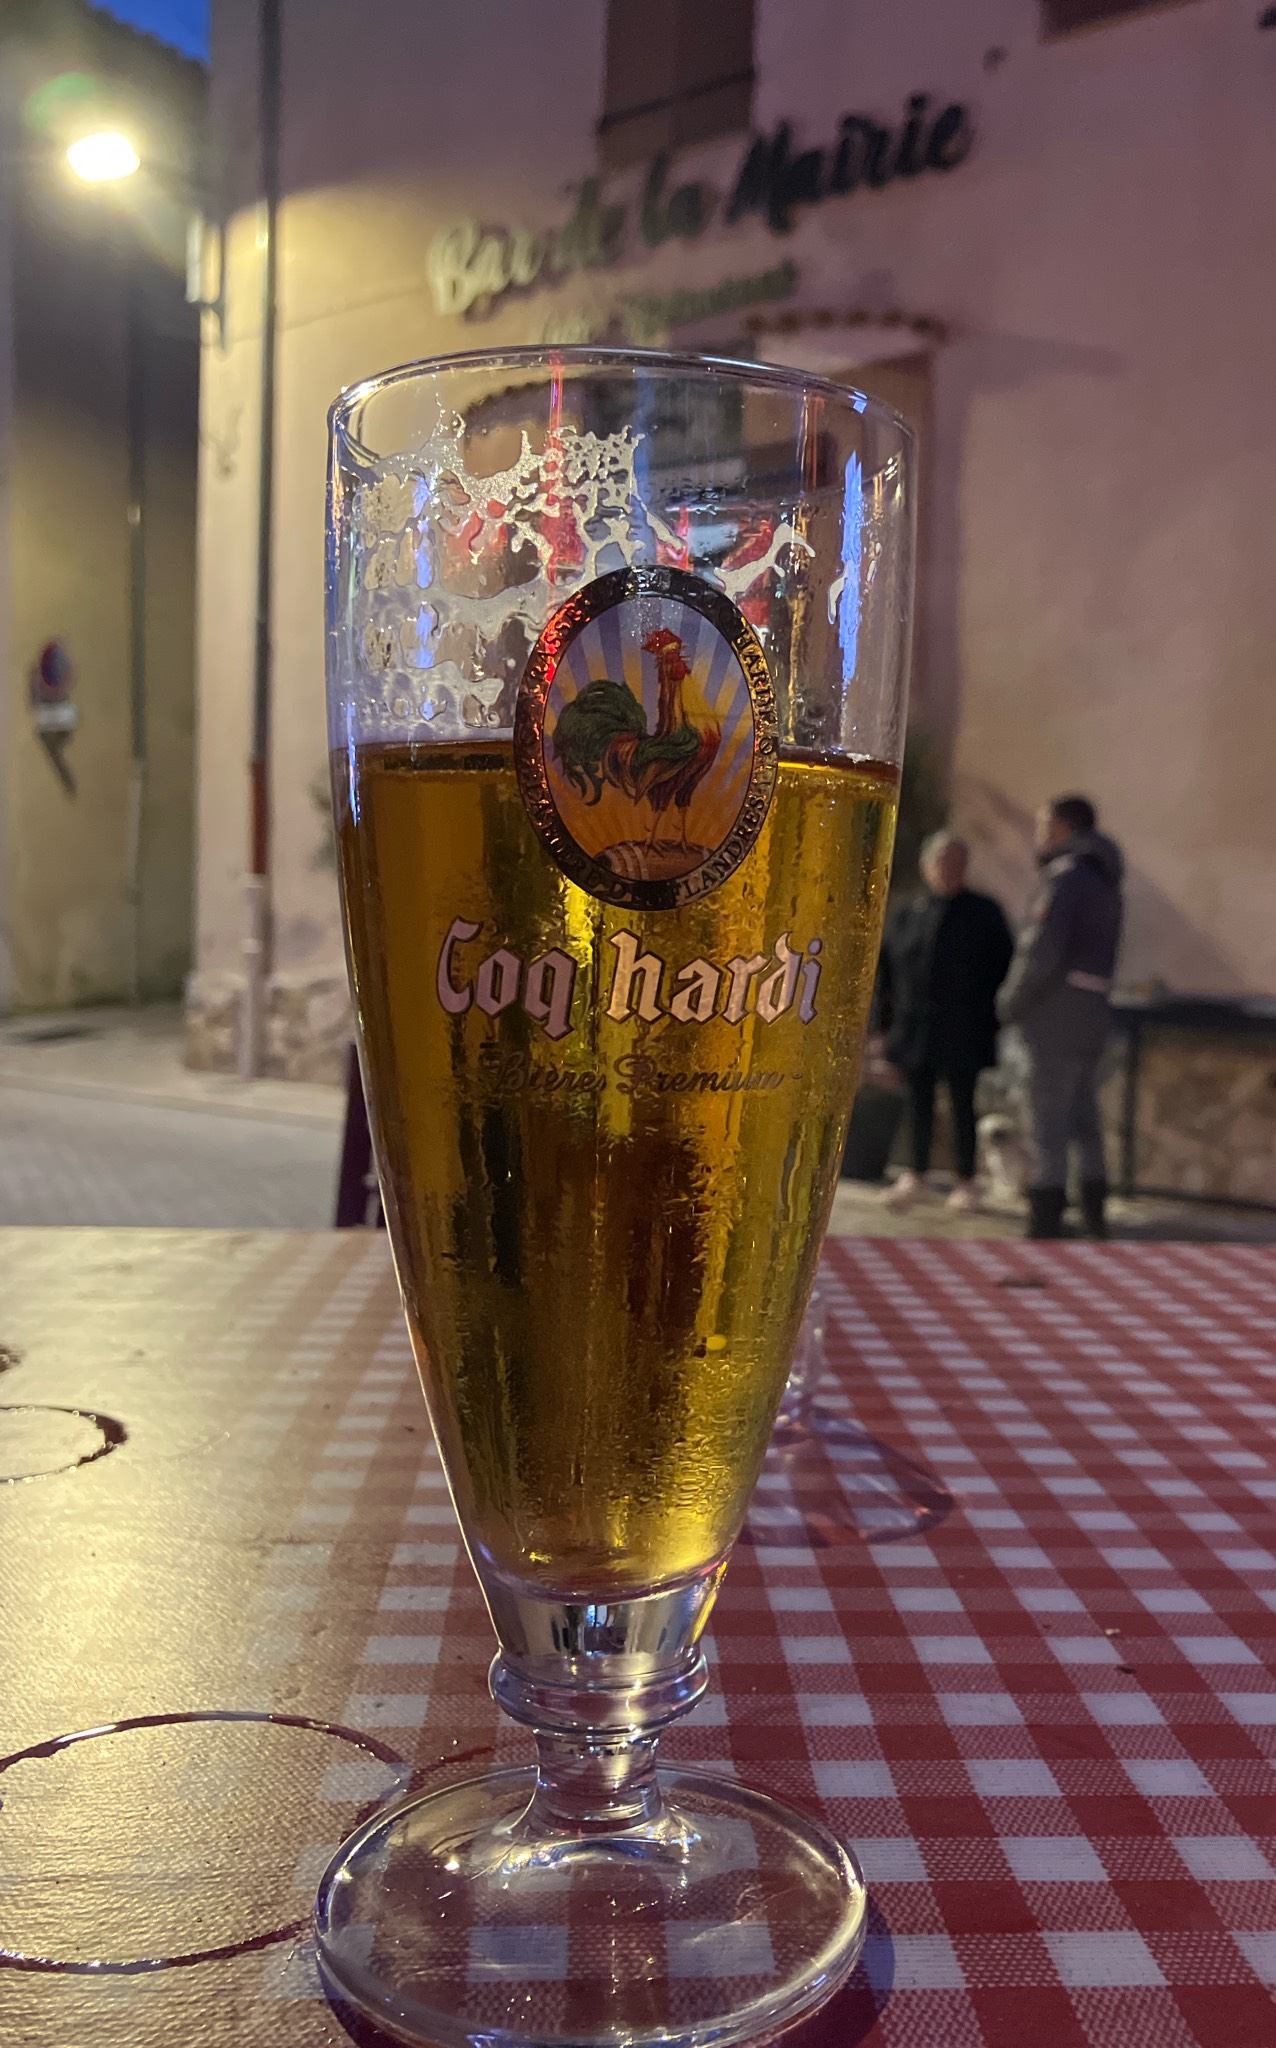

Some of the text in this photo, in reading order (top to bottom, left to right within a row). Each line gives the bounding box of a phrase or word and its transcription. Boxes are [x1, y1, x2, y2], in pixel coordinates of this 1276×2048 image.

[727, 92, 978, 235] Mairie
[436, 914, 823, 1041] Coq hardi
[613, 1052, 785, 1095] Premium
